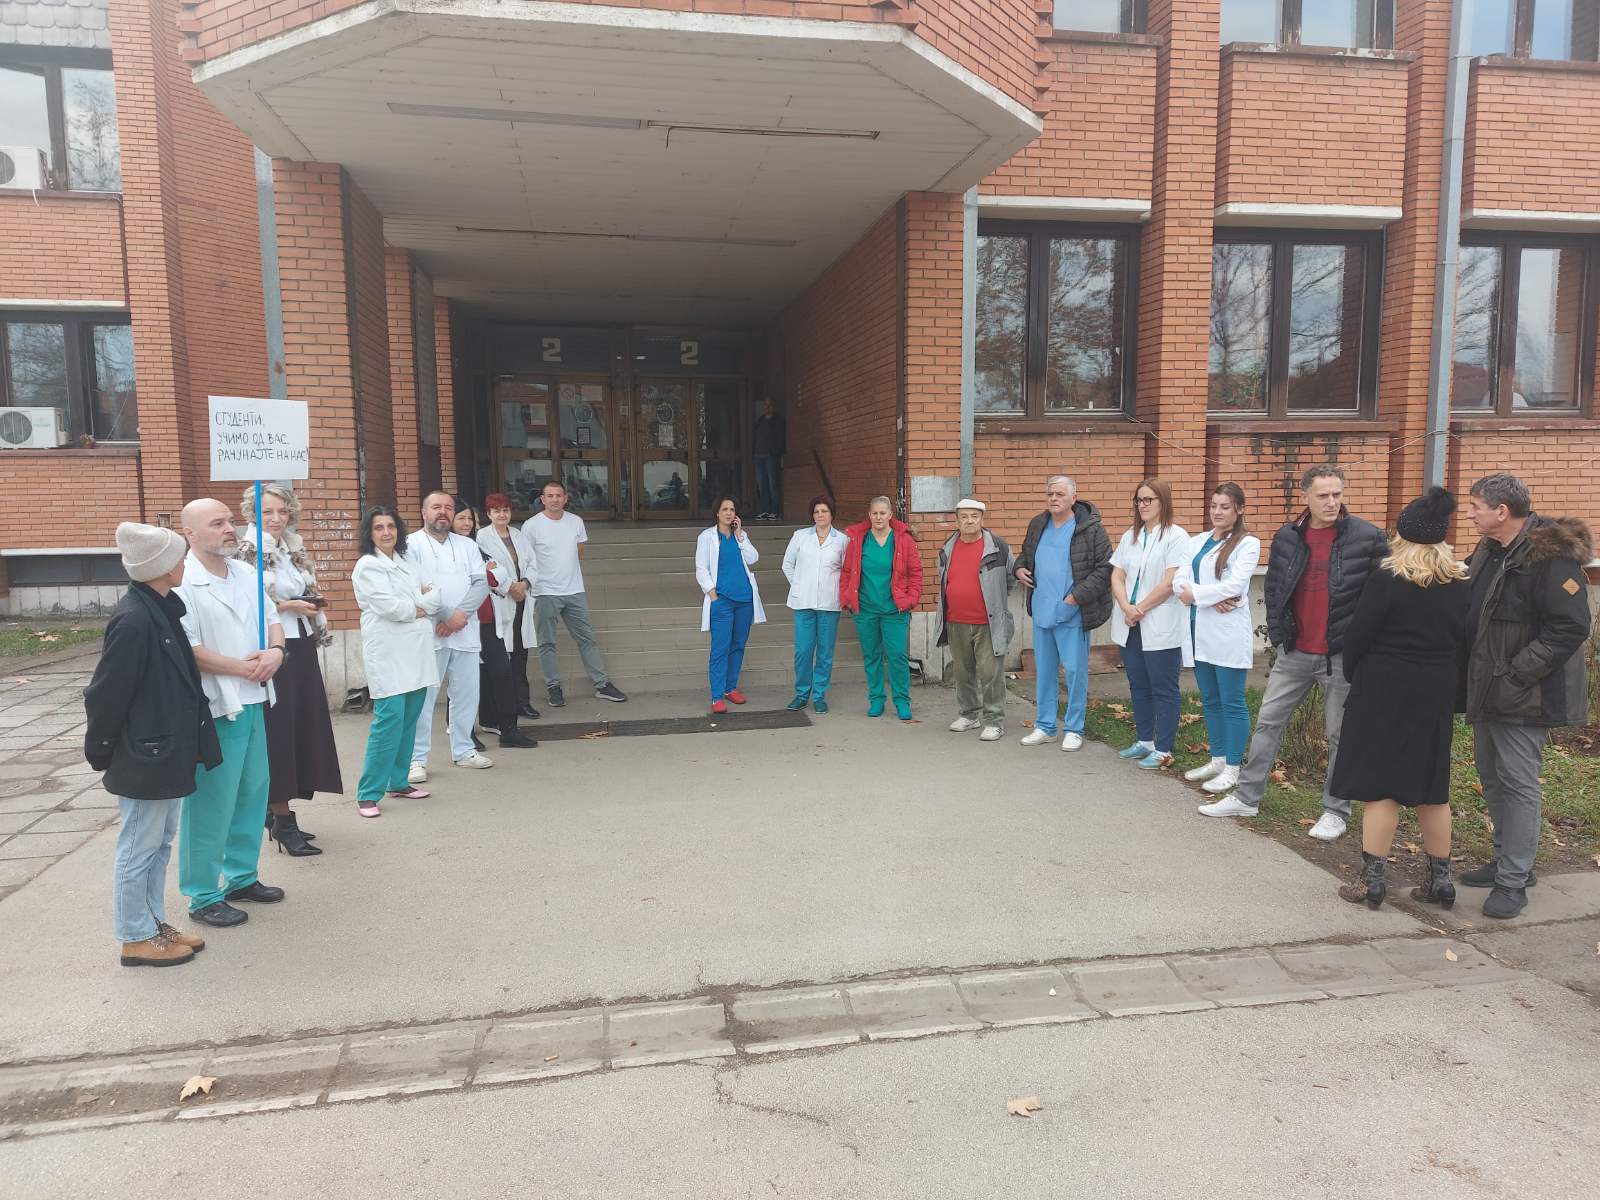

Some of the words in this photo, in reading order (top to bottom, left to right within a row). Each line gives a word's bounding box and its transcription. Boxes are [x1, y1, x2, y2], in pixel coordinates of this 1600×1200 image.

[543, 338, 561, 361] 2
[680, 341, 698, 365] 2
[217, 432, 249, 445] УЧИМО
[252, 433, 265, 447] ОД
